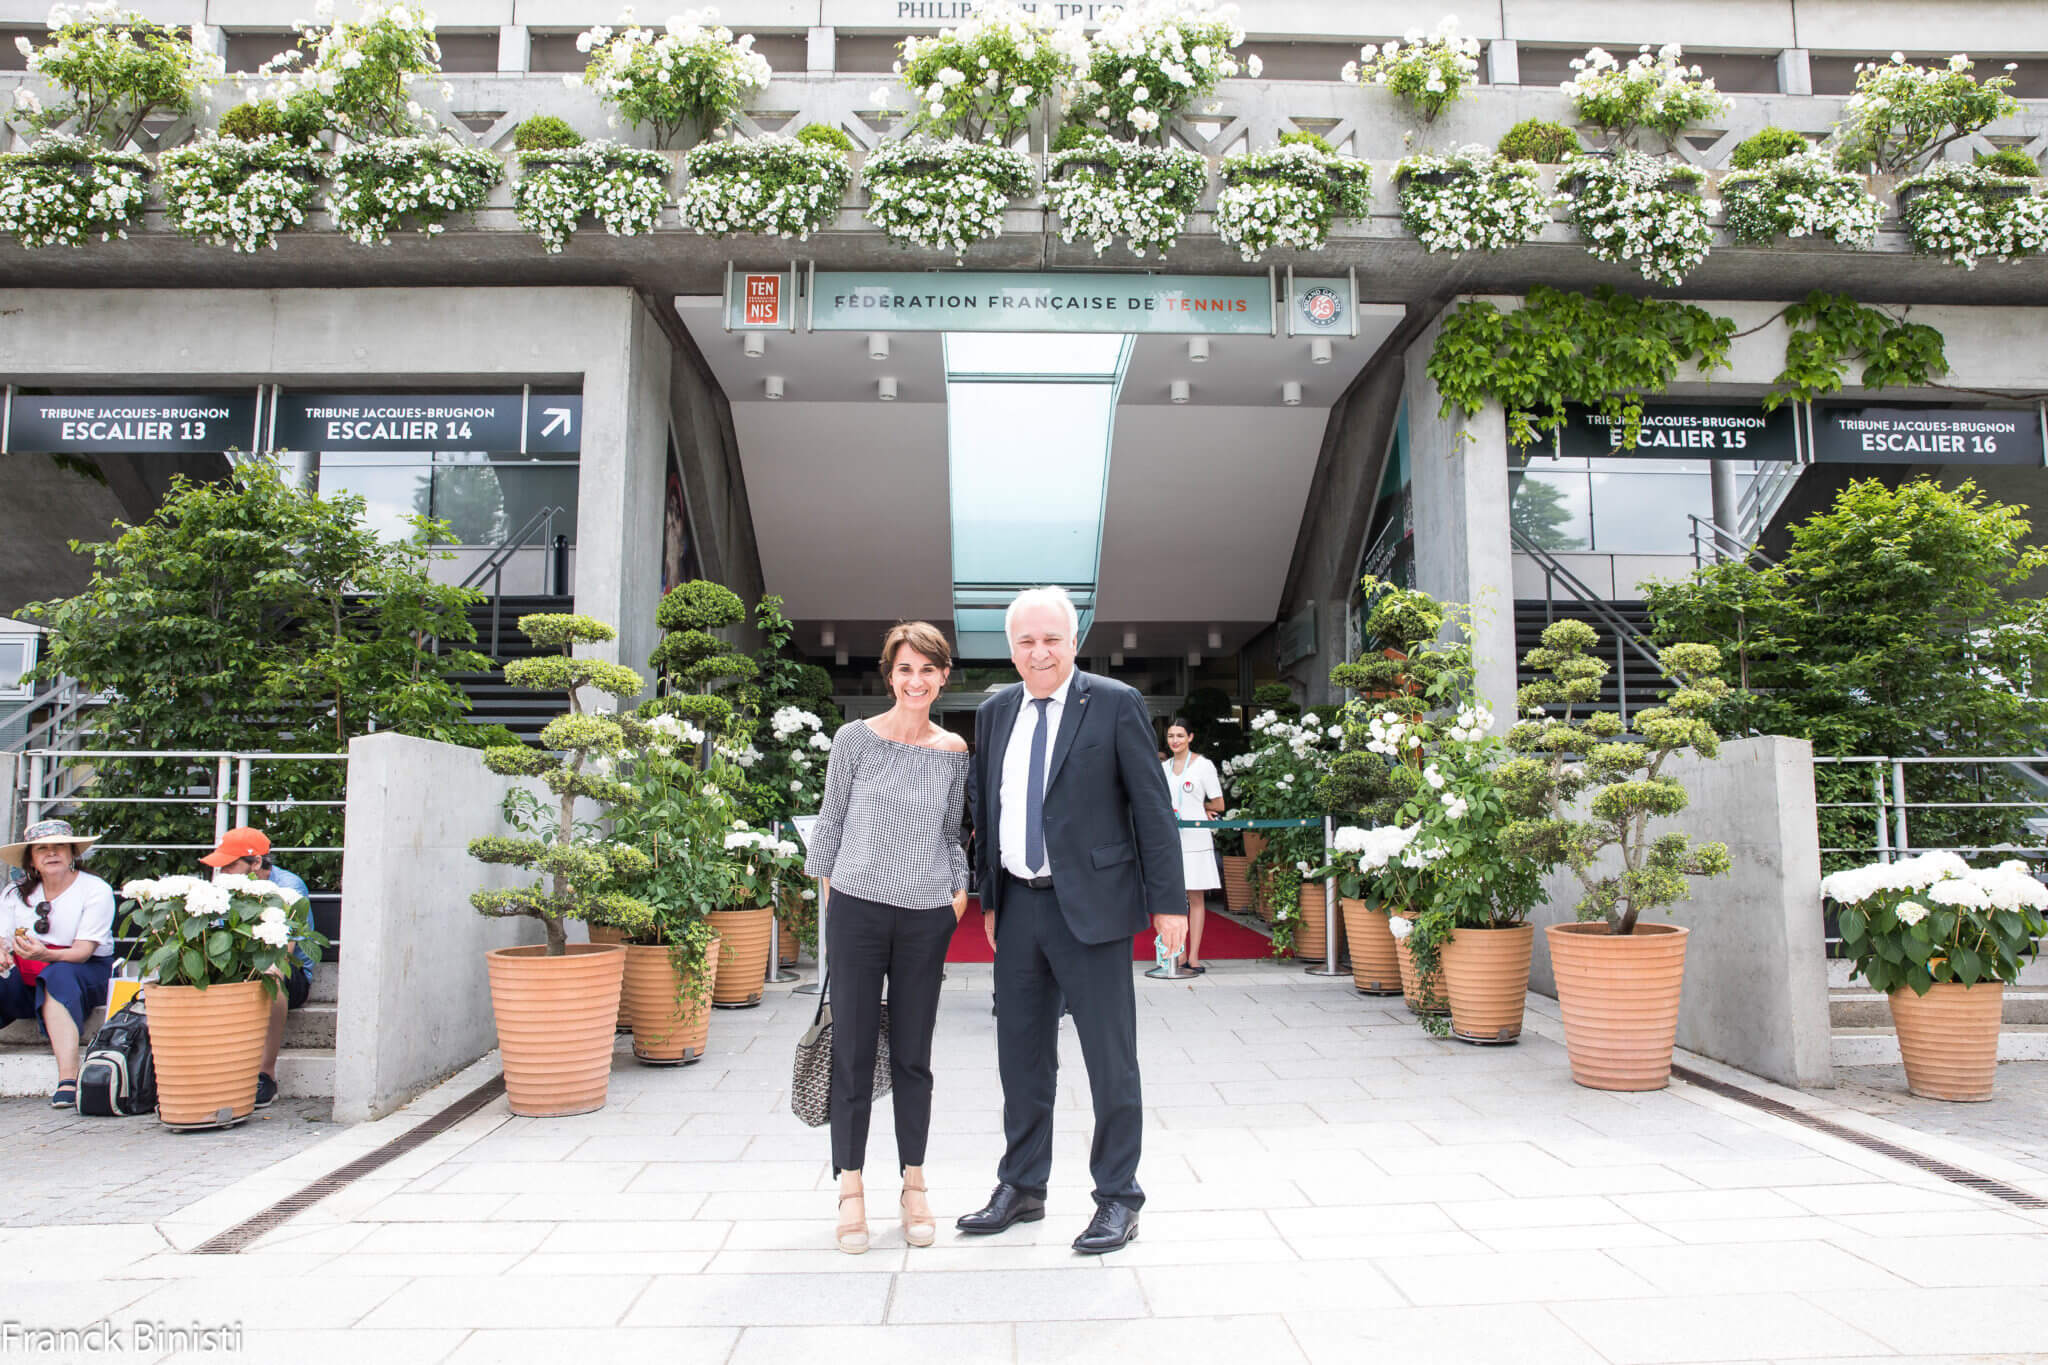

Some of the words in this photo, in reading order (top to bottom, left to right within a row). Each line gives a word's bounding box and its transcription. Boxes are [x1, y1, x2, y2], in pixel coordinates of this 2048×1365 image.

[751, 281, 774, 296] TEN
[751, 303, 773, 318] NIS
[834, 294, 977, 308] FÉDÉRATION
[988, 296, 1117, 310] FRANÇAISE
[1128, 298, 1154, 310] DE
[1167, 298, 1247, 312] TENNIS
[40, 408, 95, 419] TRIBUNE
[97, 408, 230, 420] JACQUES-BRUGNON
[305, 407, 359, 418] TRIBUNE
[362, 408, 495, 419] JACQUES-BRUGNON
[1642, 416, 1766, 428] JACQUES-BRUGNON
[1839, 419, 1890, 431] TRIBUNE
[1892, 421, 2016, 433] JACQUES-BRUGNON
[62, 422, 173, 440] ESCALIER
[180, 422, 206, 440] 13
[327, 422, 438, 440] ESCALIER
[446, 422, 472, 440] 14
[1610, 429, 1715, 448] ECALIER
[1722, 430, 1747, 448] 15
[1862, 434, 1966, 452] ESCALIER
[1971, 435, 1997, 453] 16
